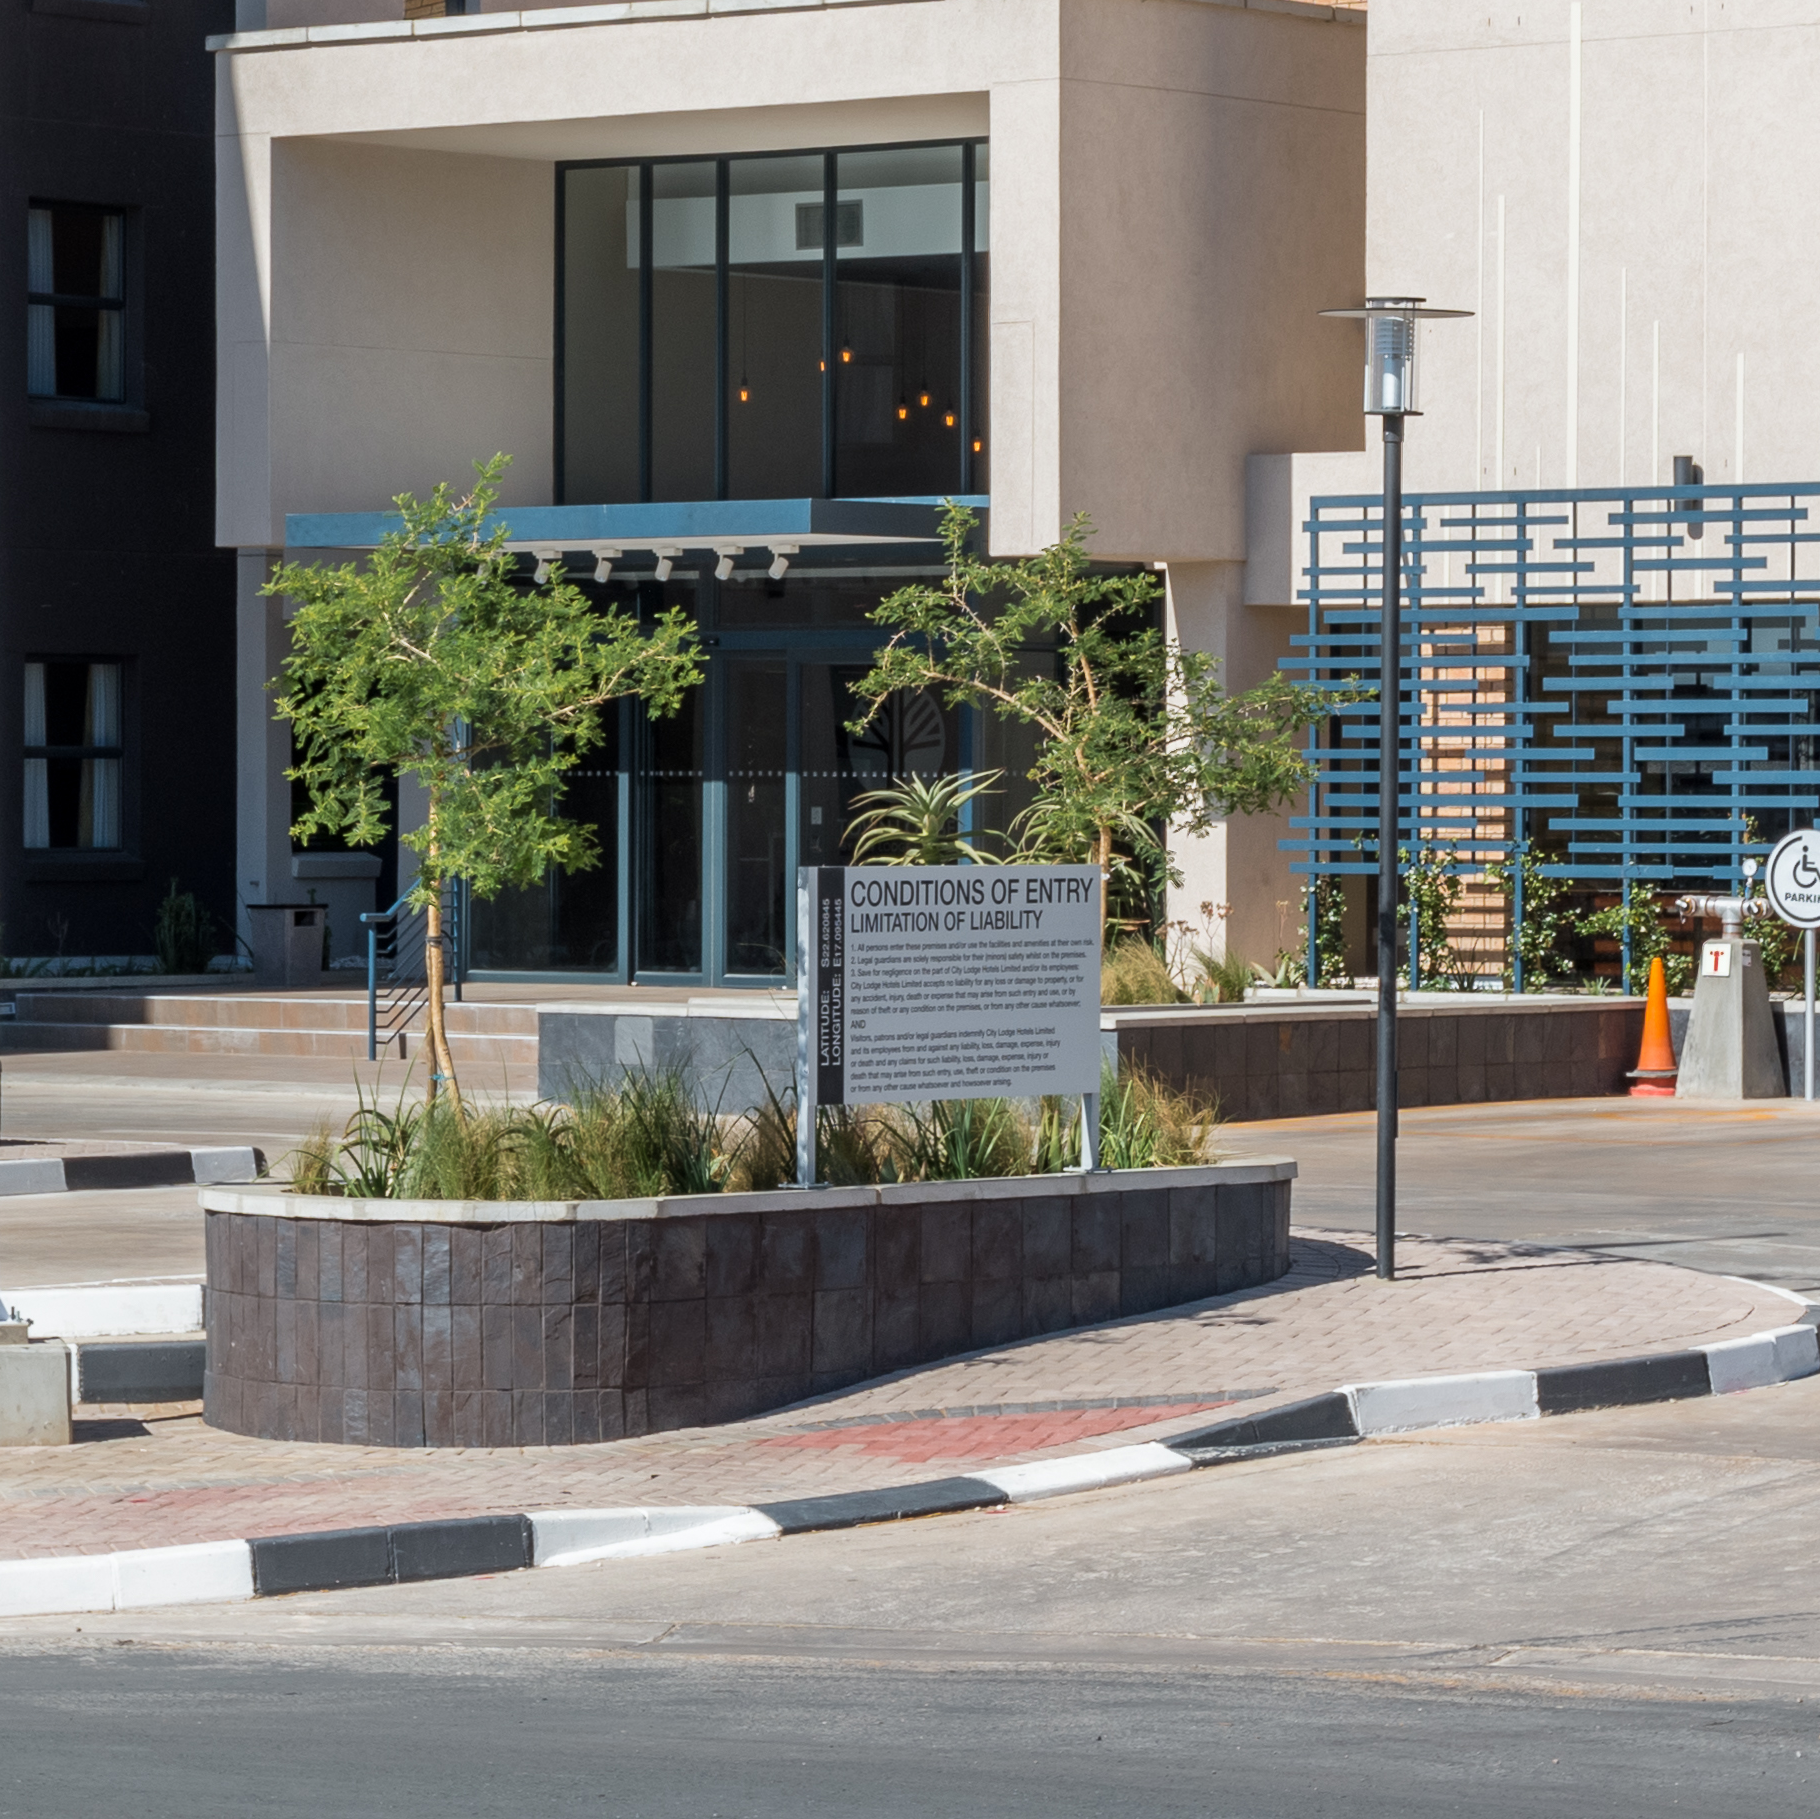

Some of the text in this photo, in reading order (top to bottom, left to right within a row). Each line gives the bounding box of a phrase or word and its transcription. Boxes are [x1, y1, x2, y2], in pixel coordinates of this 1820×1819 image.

[851, 877, 1093, 907] CONDITIONS OF ENTRY
[851, 910, 1043, 933] LIMITATION OF LIABILITY
[821, 898, 830, 1066] LATITUDE: S22.620845
[832, 898, 842, 1066] LONGITUDE: E17.095445
[851, 1020, 866, 1028] AND
